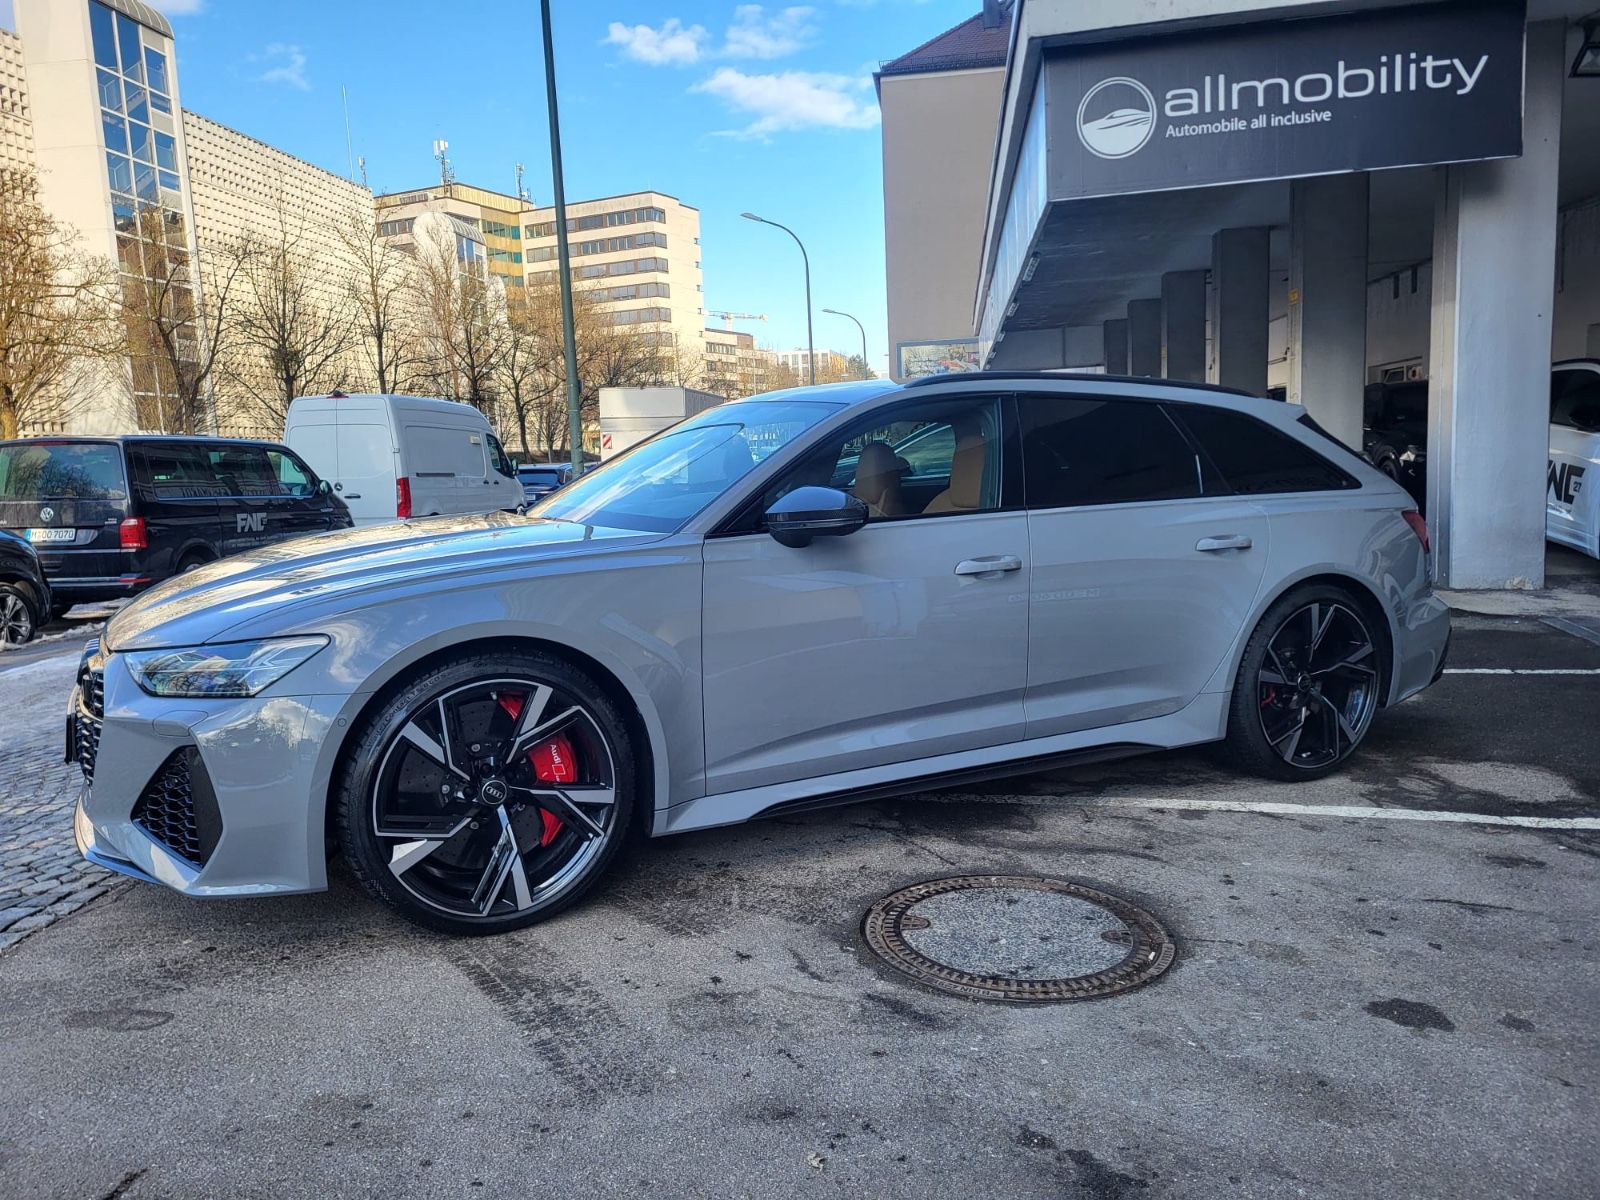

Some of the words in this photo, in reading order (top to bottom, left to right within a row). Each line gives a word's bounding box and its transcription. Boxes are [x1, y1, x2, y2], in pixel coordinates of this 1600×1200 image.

[1164, 52, 1489, 117] allmobility
[1165, 117, 1247, 138] Automobile
[1250, 114, 1267, 129] all
[1270, 110, 1332, 127] inclusive
[550, 744, 562, 764] Audi
